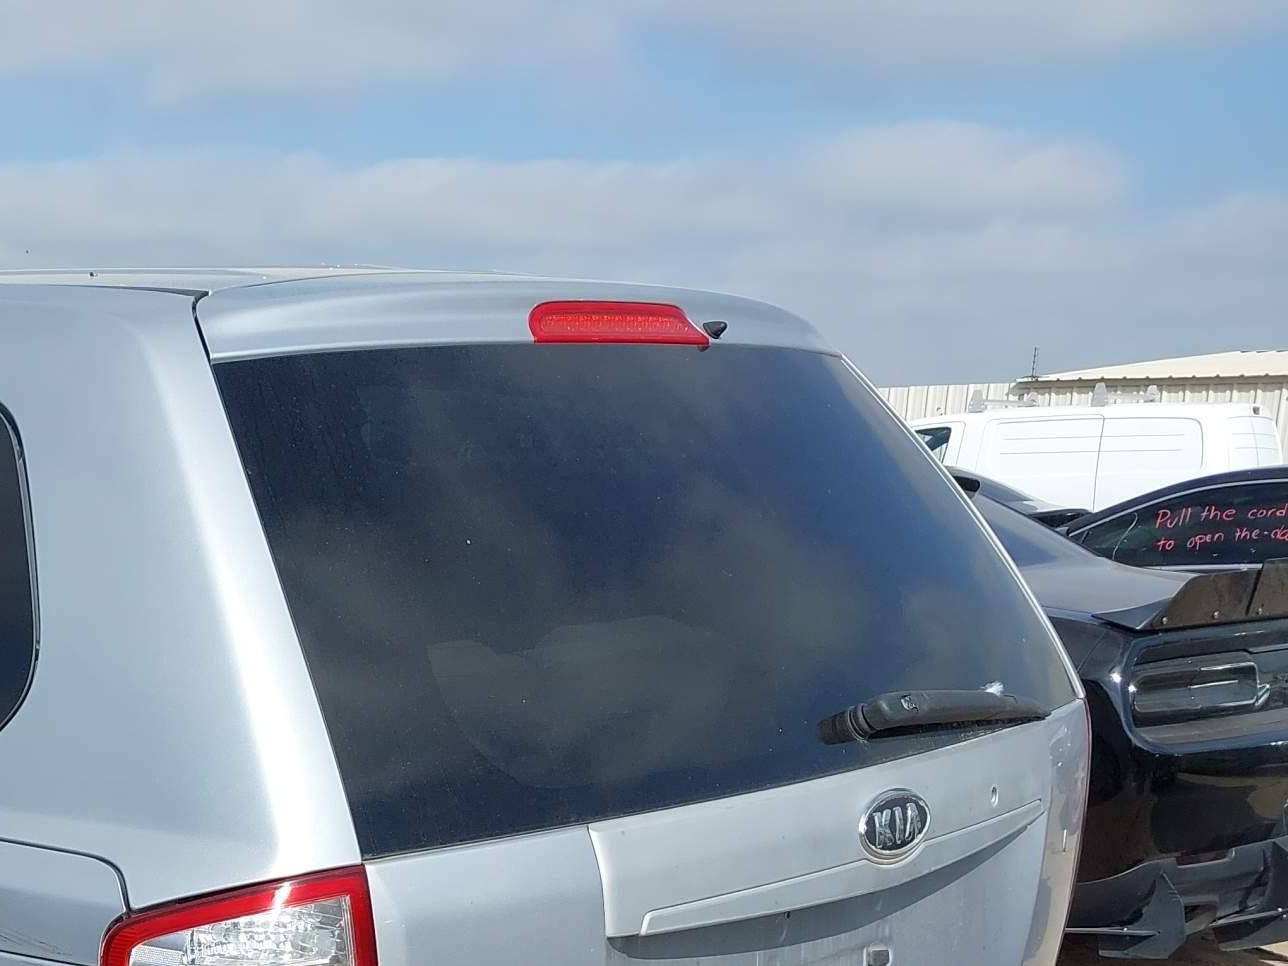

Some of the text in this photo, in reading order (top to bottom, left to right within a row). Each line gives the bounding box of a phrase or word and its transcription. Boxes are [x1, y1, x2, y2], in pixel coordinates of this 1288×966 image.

[1155, 506, 1192, 528] Pull
[1200, 505, 1236, 521] the
[1156, 538, 1175, 551] to
[1187, 532, 1225, 550] open
[872, 802, 922, 849] KIA
